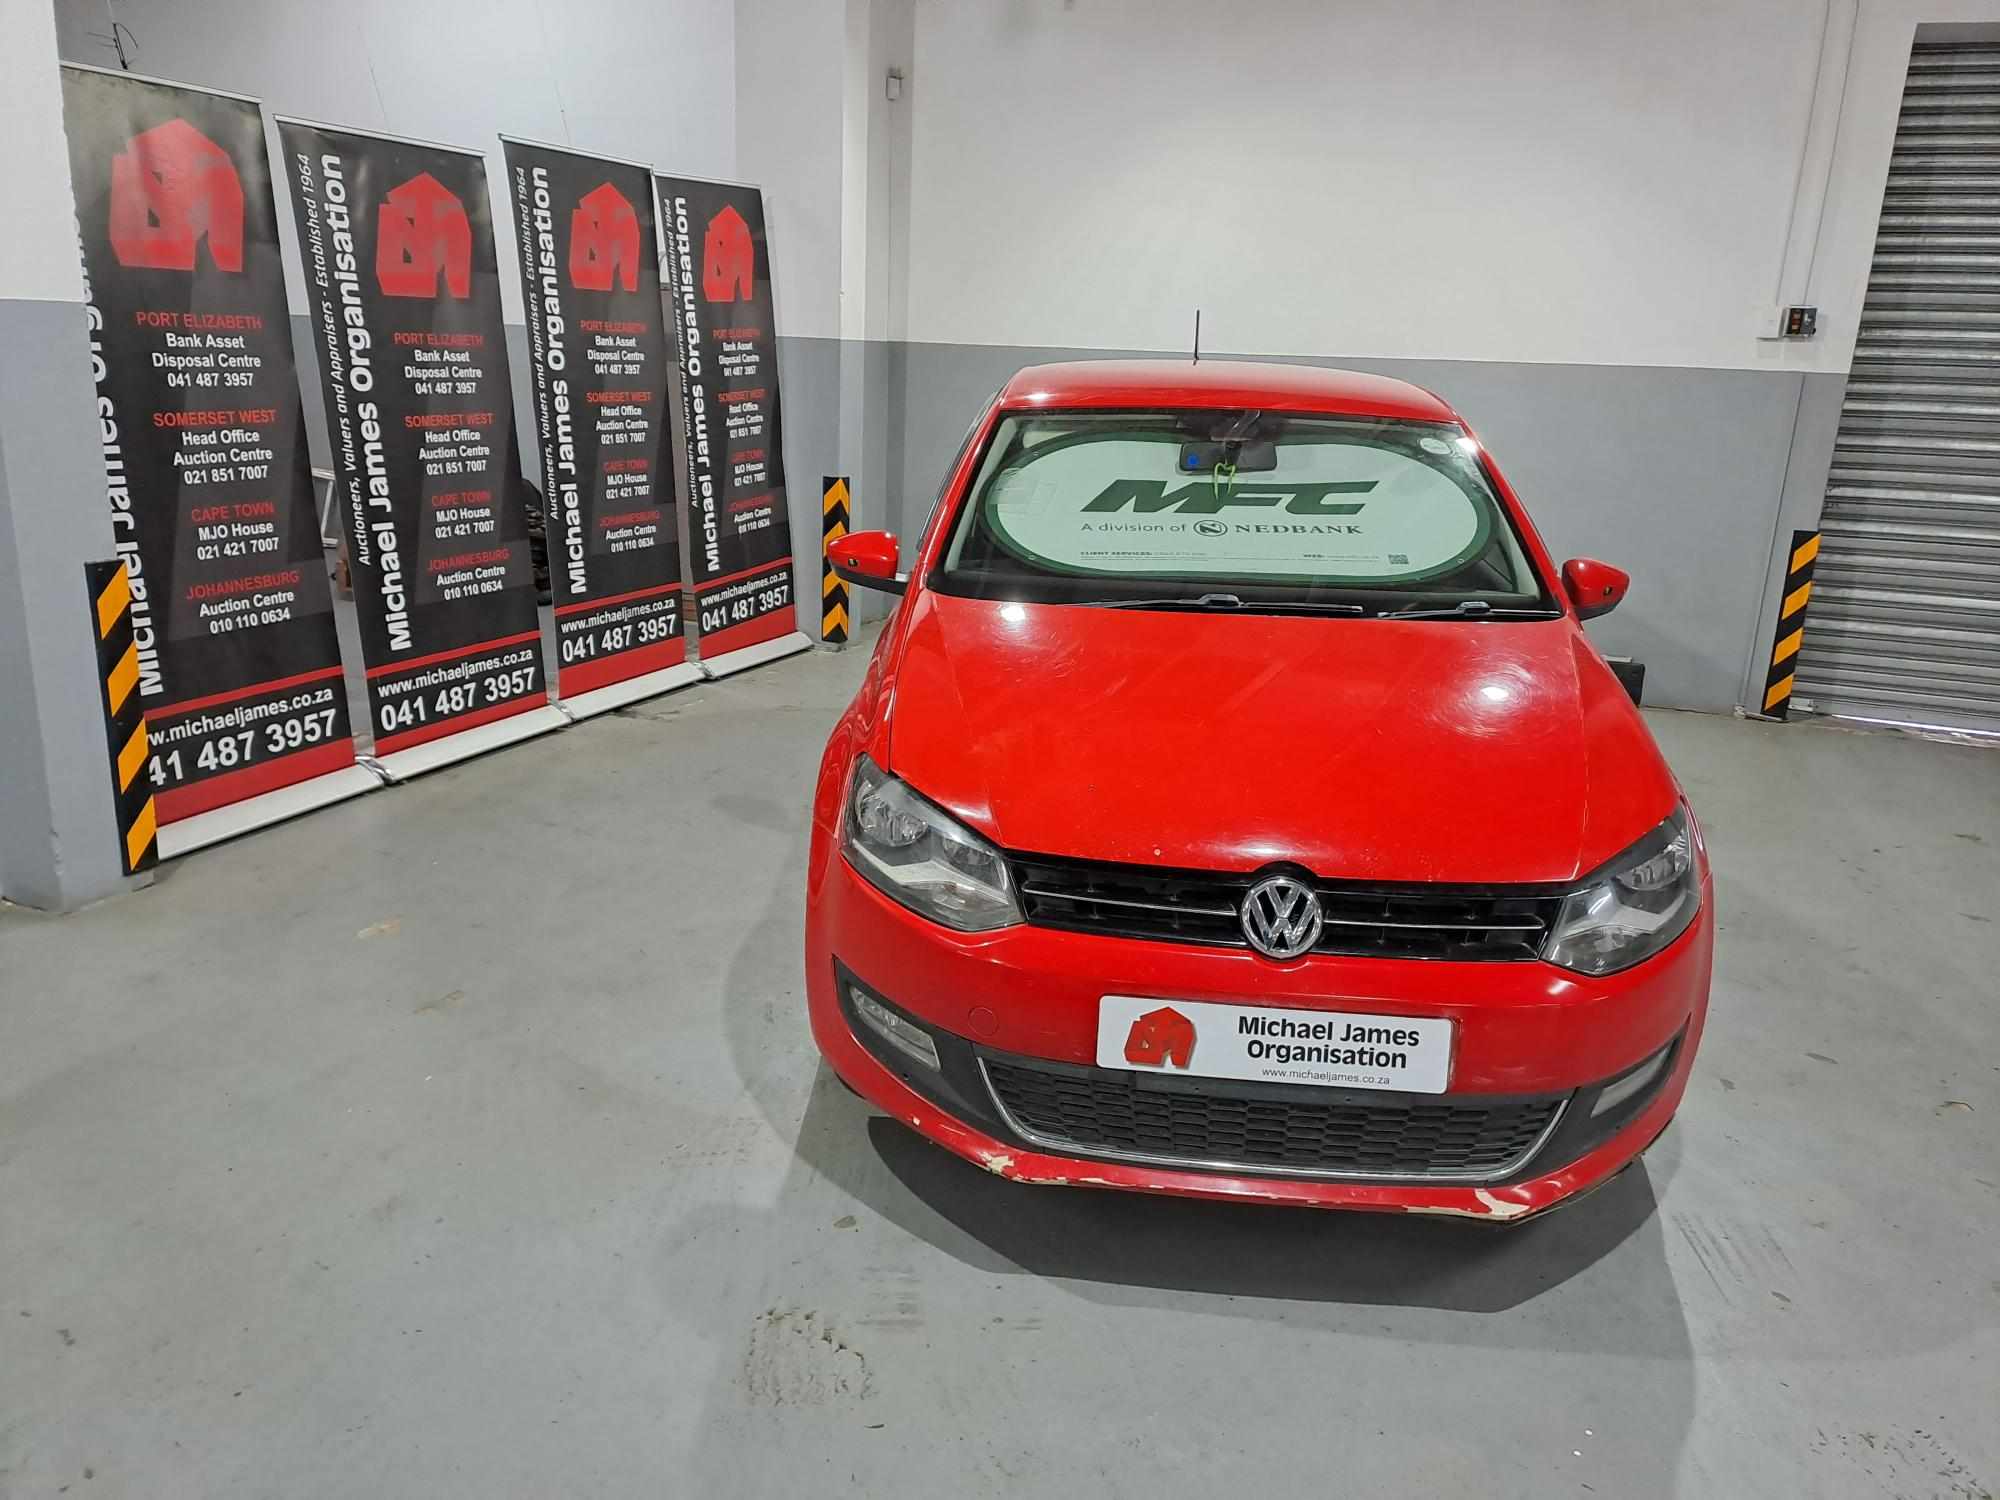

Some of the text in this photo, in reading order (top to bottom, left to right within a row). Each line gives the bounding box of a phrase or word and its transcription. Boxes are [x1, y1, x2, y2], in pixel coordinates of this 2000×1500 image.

[136, 312, 263, 330] PORT ELIZABETH
[166, 333, 245, 348] Bank Asset
[152, 353, 261, 370] Disposal Centre
[297, 153, 371, 565] Auctioneers, Valuers and Appraisers Established 1964
[414, 350, 470, 362] Bank Asset
[587, 349, 645, 361] Disposal Centre
[167, 372, 254, 387] 041 487 3957
[404, 366, 482, 380] Disposal Centre
[415, 382, 476, 394] 041 487 3957
[153, 409, 276, 427] SOMERSET WEST
[553, 379, 576, 475] James
[595, 419, 648, 431] Auction Centre
[692, 384, 710, 468] James
[181, 429, 260, 446] Head Office
[425, 429, 481, 443] Head Office
[173, 448, 273, 467] Auction Centre
[358, 402, 392, 513] James
[419, 445, 490, 460] Auction Centre
[184, 465, 268, 484] 021 851 7007
[426, 460, 487, 475] 021 851 7007
[1080, 479, 1380, 515] MFC
[191, 502, 274, 522] CAPE TOWN
[436, 508, 491, 522] MJO House
[199, 521, 273, 541] MJO House
[435, 520, 495, 538] 021 421 7007
[606, 525, 657, 540] Auction Centre
[699, 474, 720, 572] Michael
[1080, 521, 1364, 535] A division of NEDBANK
[560, 482, 587, 594] Michael
[197, 537, 280, 560] 021 421 7007
[186, 570, 299, 600] JOHANNESBURG
[371, 521, 413, 651] Michael
[436, 566, 506, 586] Auction Centre
[444, 580, 503, 600] 010 110 0634
[701, 572, 787, 606] www.michaeljames.co.za
[200, 590, 294, 617] Auction Centre
[702, 585, 788, 631] 041 487 3957
[210, 608, 291, 634] 010 110 0634
[560, 599, 675, 633] www.michaeljames.co.za
[562, 614, 676, 662] 041 487 3957
[377, 649, 533, 698] www.michaeljames.co.za
[380, 666, 535, 731] 041 487 3957
[148, 688, 333, 746] w.michaeljames.co.za
[149, 708, 337, 786] 41 487 3957
[1238, 1015, 1420, 1047] Michael James
[1247, 1040, 1407, 1069] Organisation
[1262, 1068, 1390, 1085] www.michaeljames.co.za
